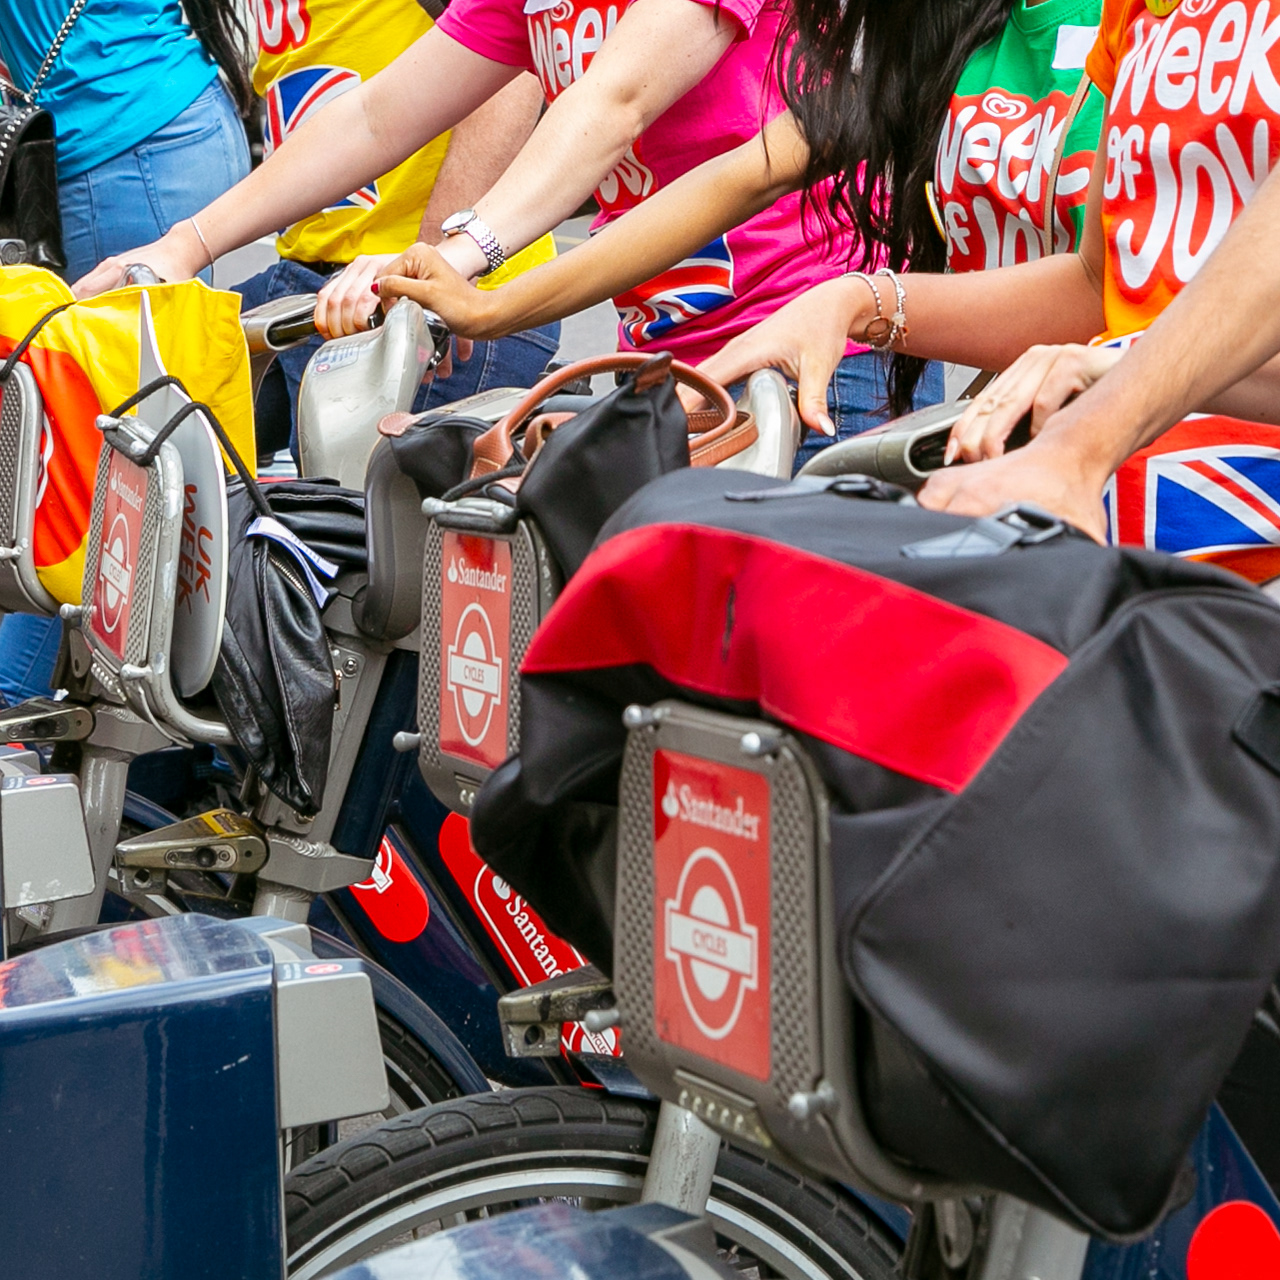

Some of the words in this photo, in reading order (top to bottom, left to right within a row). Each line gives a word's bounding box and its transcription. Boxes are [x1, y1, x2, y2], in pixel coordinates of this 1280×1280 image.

[116, 470, 144, 513] Santander
[195, 525, 214, 604] UK
[458, 557, 506, 594] Santander
[463, 664, 485, 684] CYCLES
[678, 783, 760, 842] Santander
[692, 928, 728, 958] CYCLES
